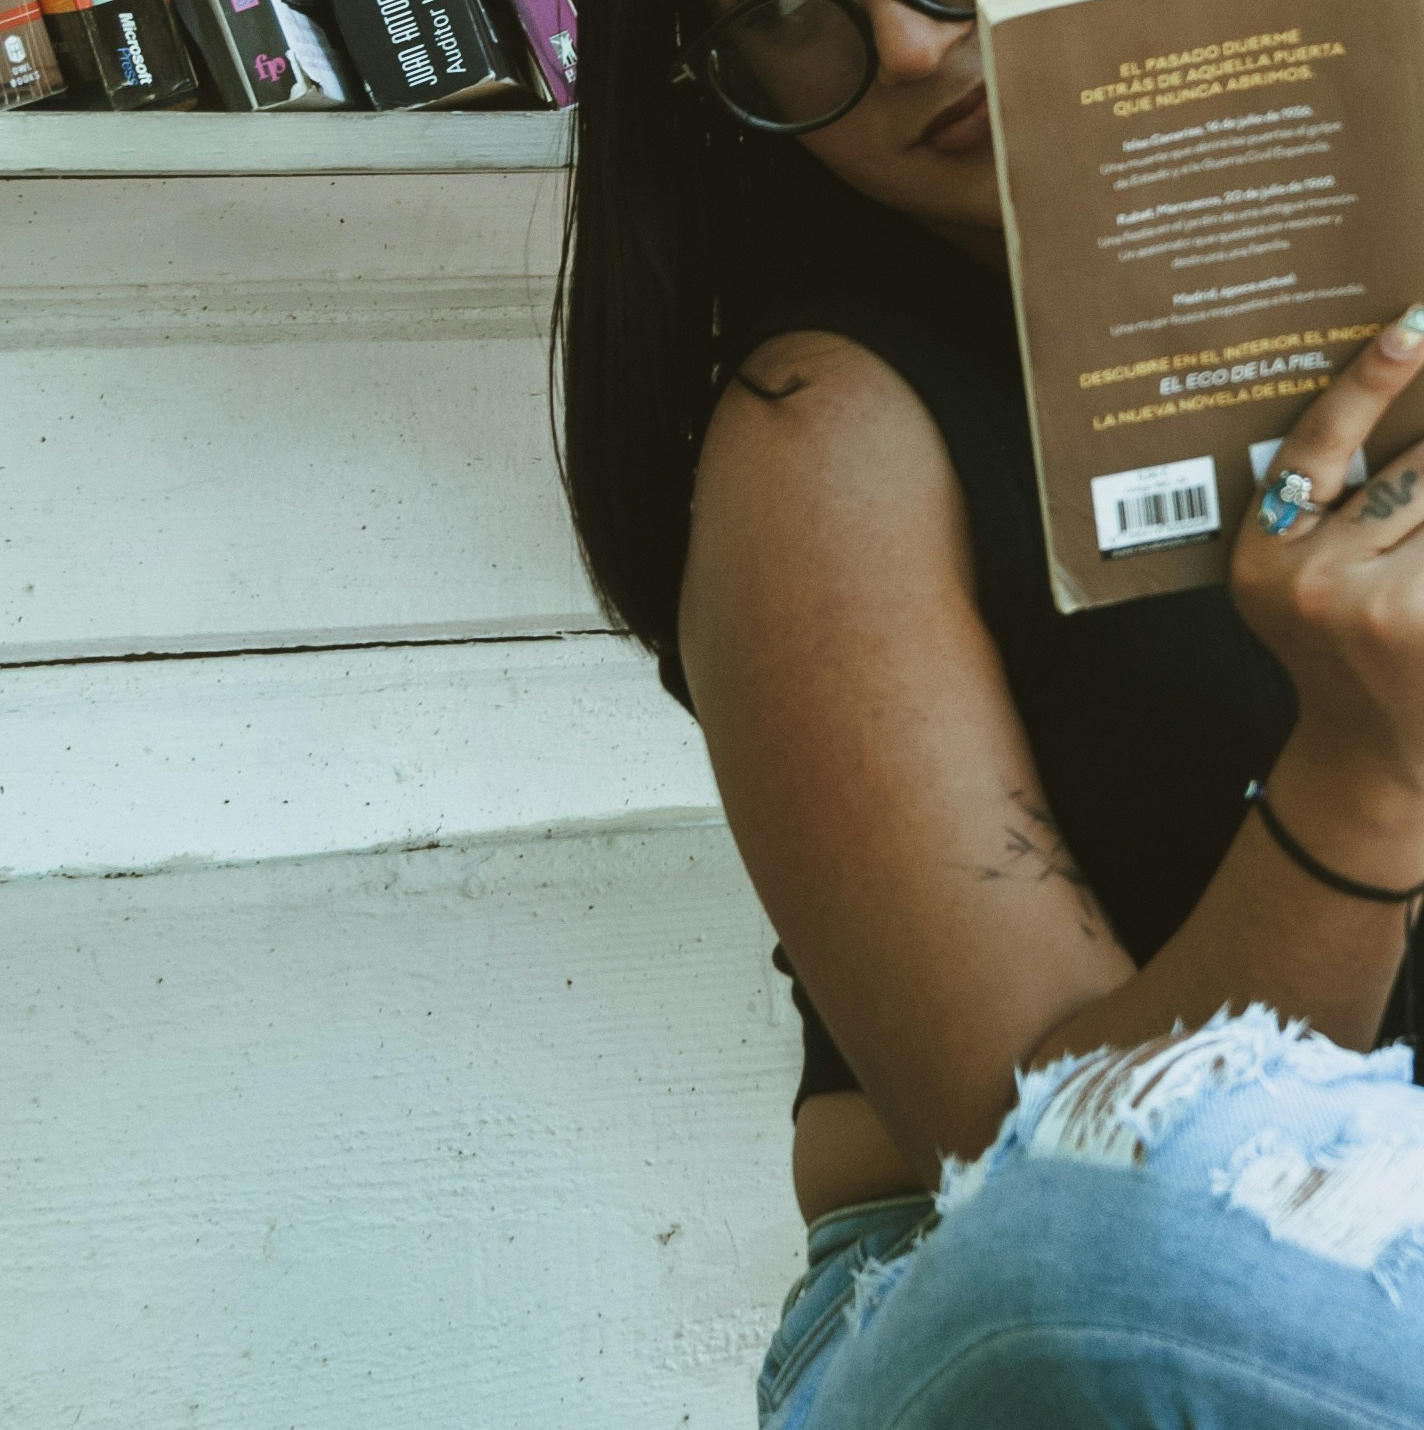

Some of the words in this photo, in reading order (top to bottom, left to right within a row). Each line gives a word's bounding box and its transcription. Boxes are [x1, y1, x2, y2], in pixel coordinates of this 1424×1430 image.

[116, 46, 140, 86] Press
[118, 11, 153, 86] Microsoft
[397, 44, 438, 88] JUAN
[430, 7, 468, 75] Auditor
[1120, 61, 1141, 78] EL
[1145, 44, 1222, 72] PASADO
[1221, 27, 1303, 56] DUERME
[1080, 76, 1156, 106] DETRÁS
[1156, 70, 1184, 90] DE
[1185, 52, 1273, 82] AQUELLA
[1273, 41, 1346, 64] PUERTA
[1113, 99, 1154, 118] QUE
[1154, 83, 1223, 108] NUNCA
[1225, 63, 1317, 92] ABRIMOS.
